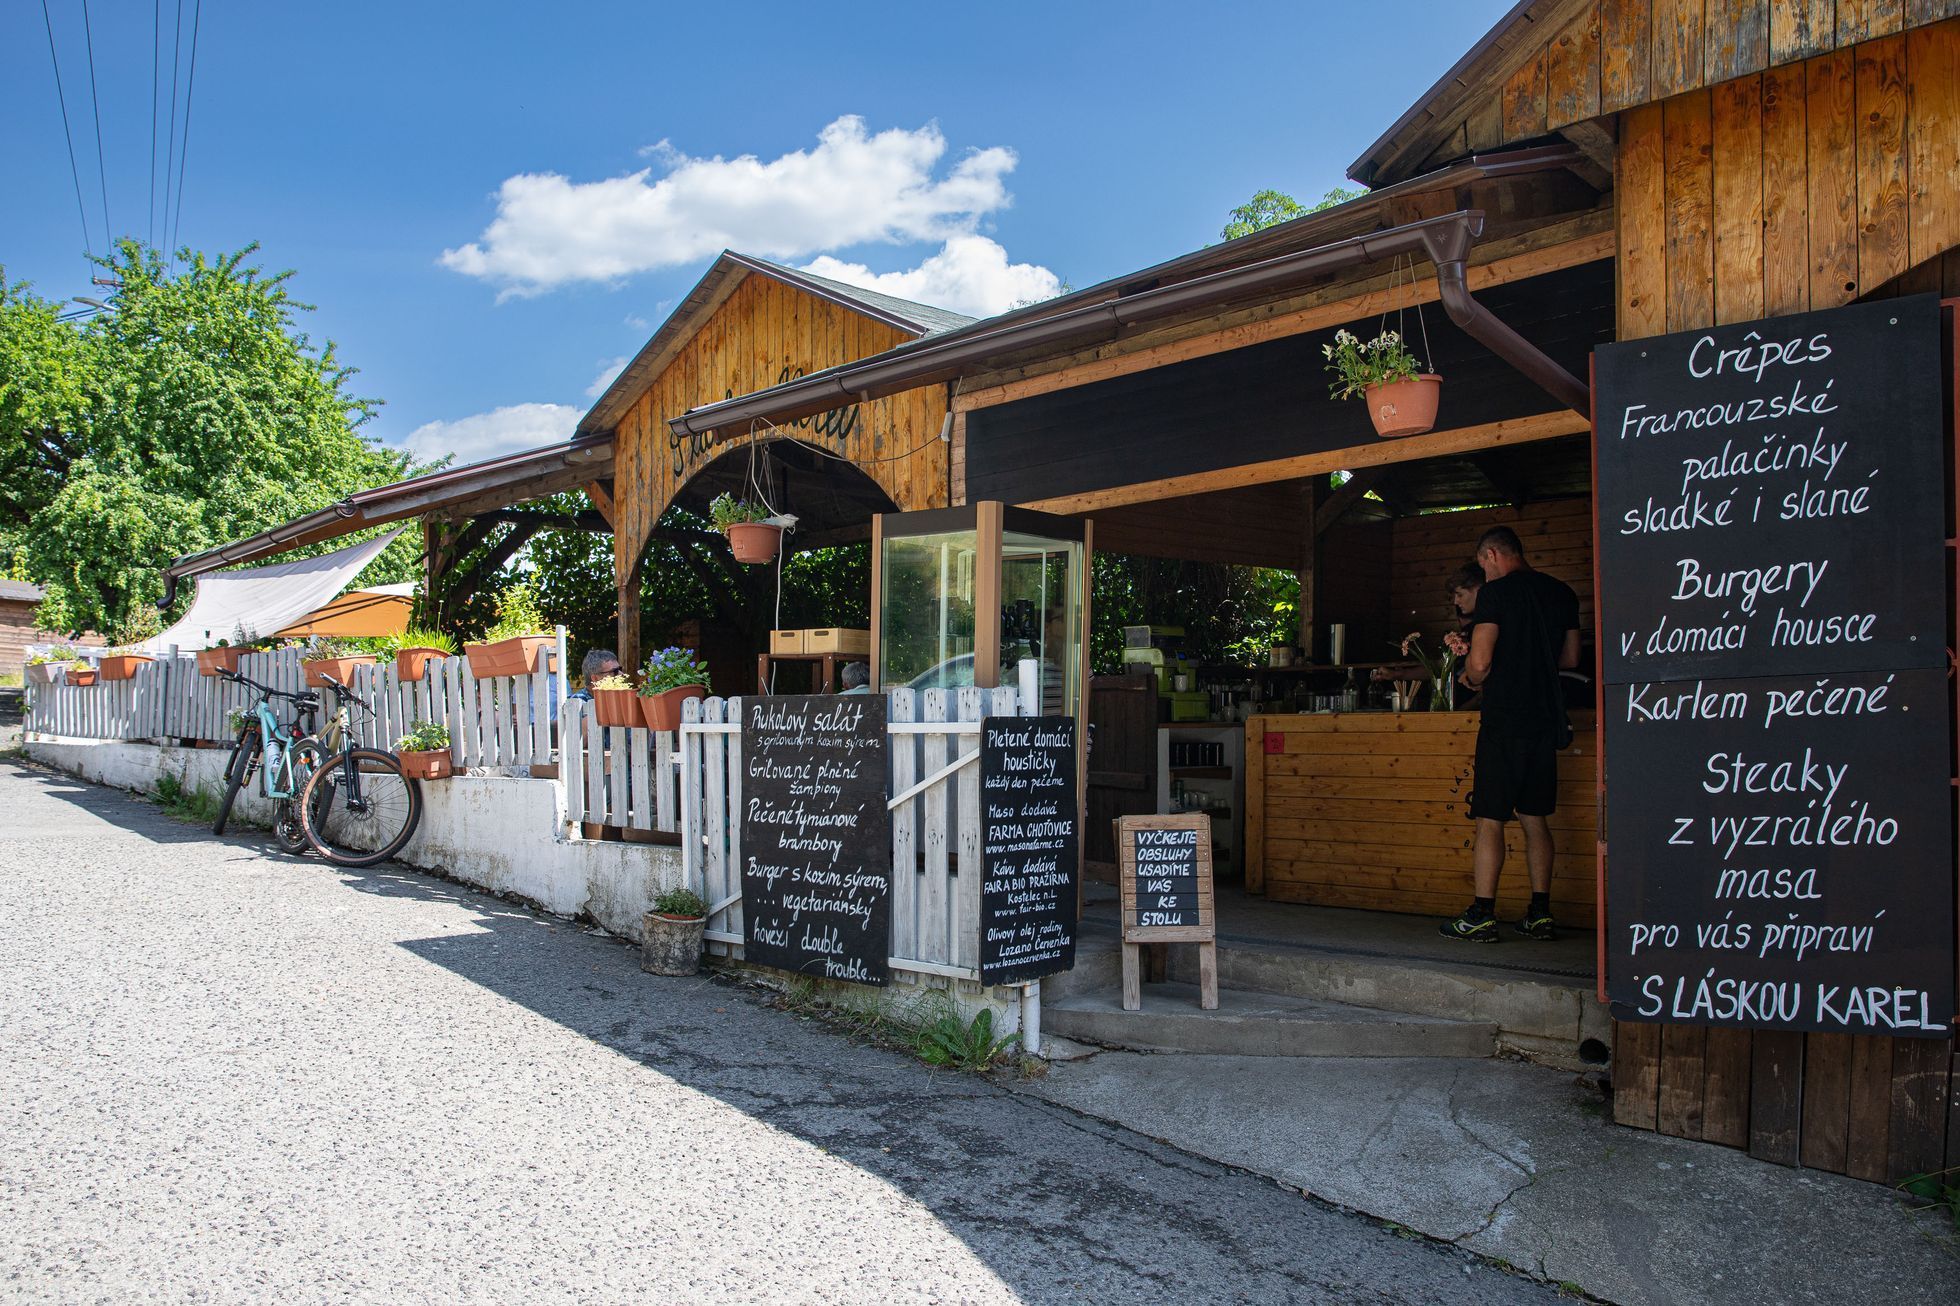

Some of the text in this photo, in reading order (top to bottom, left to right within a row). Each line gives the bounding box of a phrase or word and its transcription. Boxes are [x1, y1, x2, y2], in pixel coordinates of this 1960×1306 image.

[1689, 332, 1832, 382] Crêpes
[1621, 380, 1838, 439] Francouzské
[1682, 427, 1847, 495] palačinky
[1621, 470, 1878, 534] sladké i slané
[1671, 558, 1828, 612] Burgery
[1622, 608, 1876, 656] v domácí housce
[1627, 674, 1894, 728] Karlem pečené
[813, 703, 863, 731] salát
[845, 736, 880, 755] sýrem
[988, 726, 1072, 748] Pletené domácí
[750, 756, 861, 786] Grilované plněné
[1004, 749, 1056, 777] houstičky
[789, 780, 841, 801] žampiony
[985, 774, 1064, 793] každý den pečeme
[1703, 748, 1848, 808] Steaky
[748, 798, 796, 823] Pečené
[989, 800, 1057, 818] Maso dodává
[989, 825, 1024, 841] FARMA
[1138, 830, 1197, 845] VYČKEJTE
[1668, 800, 1898, 860] z vyzrálého
[779, 831, 842, 861] brambory
[1138, 848, 1192, 860] OBSLUHY
[747, 857, 887, 898] Burger s kozím sýrem,
[993, 855, 1057, 876] Kávu dodává
[1138, 862, 1190, 876] USADÍME
[984, 872, 1069, 895] FAIR A BIO PRAŽÍRNA
[1008, 890, 1040, 904] Kostelec
[1148, 878, 1172, 893] VÁS
[1715, 868, 1822, 899] masa
[783, 890, 875, 930] vegetariánský
[1158, 896, 1177, 908] KE
[988, 921, 1063, 943] Olivový olej rodiny
[1141, 912, 1181, 926] STOLU
[754, 917, 843, 954] hovězí double
[999, 934, 1070, 956] Lozano Červenka
[1630, 910, 1885, 961] pro vás připraví
[1638, 968, 1947, 1030] S LÁSKOU KAREL
